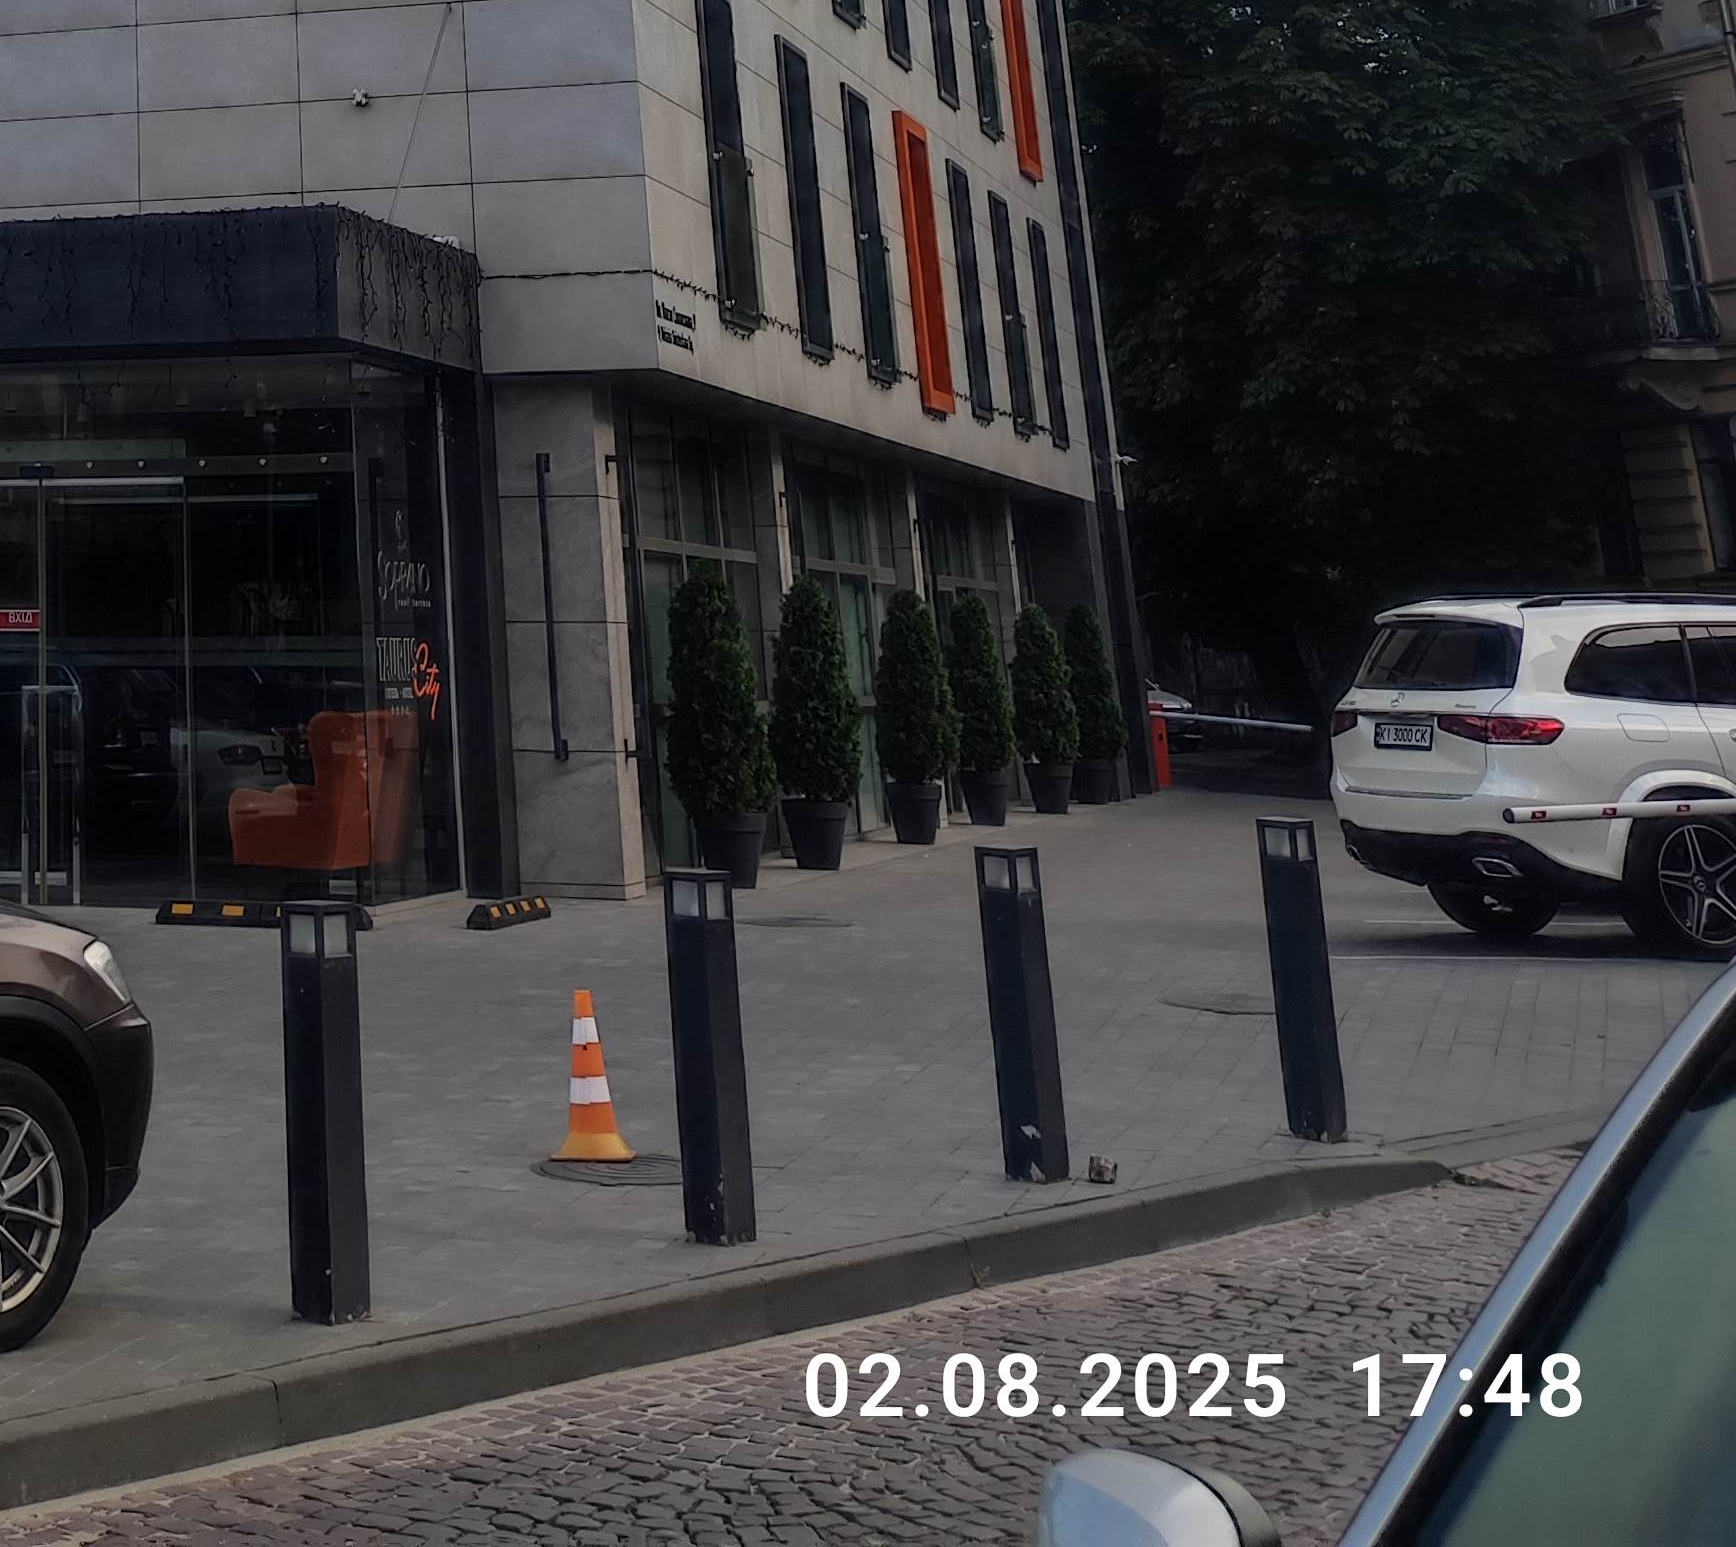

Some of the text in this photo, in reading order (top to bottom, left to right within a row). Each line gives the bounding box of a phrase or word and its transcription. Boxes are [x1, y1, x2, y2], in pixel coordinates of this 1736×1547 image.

[8, 612, 33, 623] ВХІД
[412, 642, 440, 721] City
[1415, 728, 1428, 744] CK
